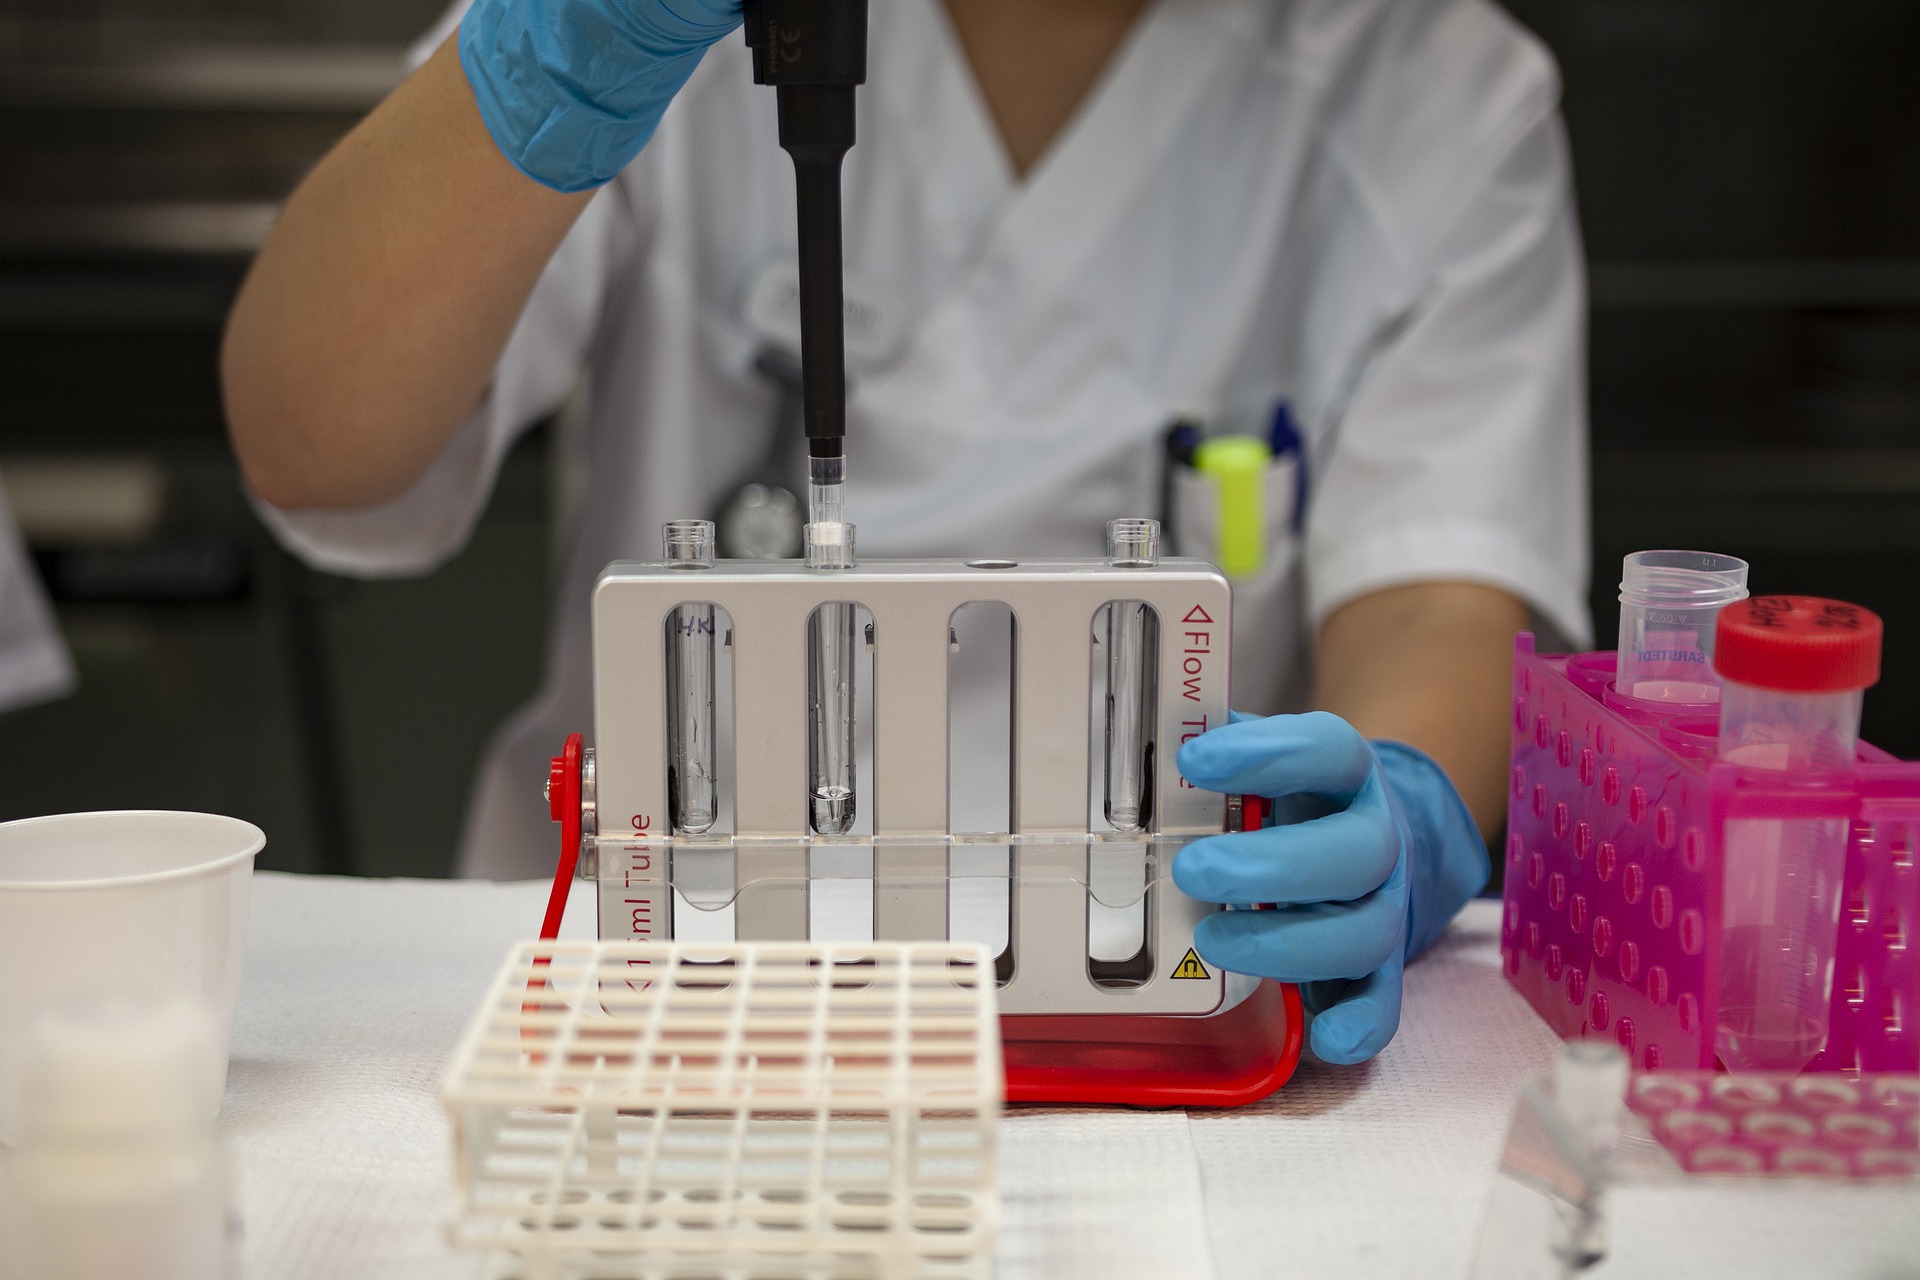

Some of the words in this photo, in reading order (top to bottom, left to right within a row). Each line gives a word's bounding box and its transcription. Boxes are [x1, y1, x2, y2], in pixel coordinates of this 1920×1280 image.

[781, 28, 802, 63] CE
[1182, 631, 1211, 702] Flow
[624, 814, 651, 888] Tube
